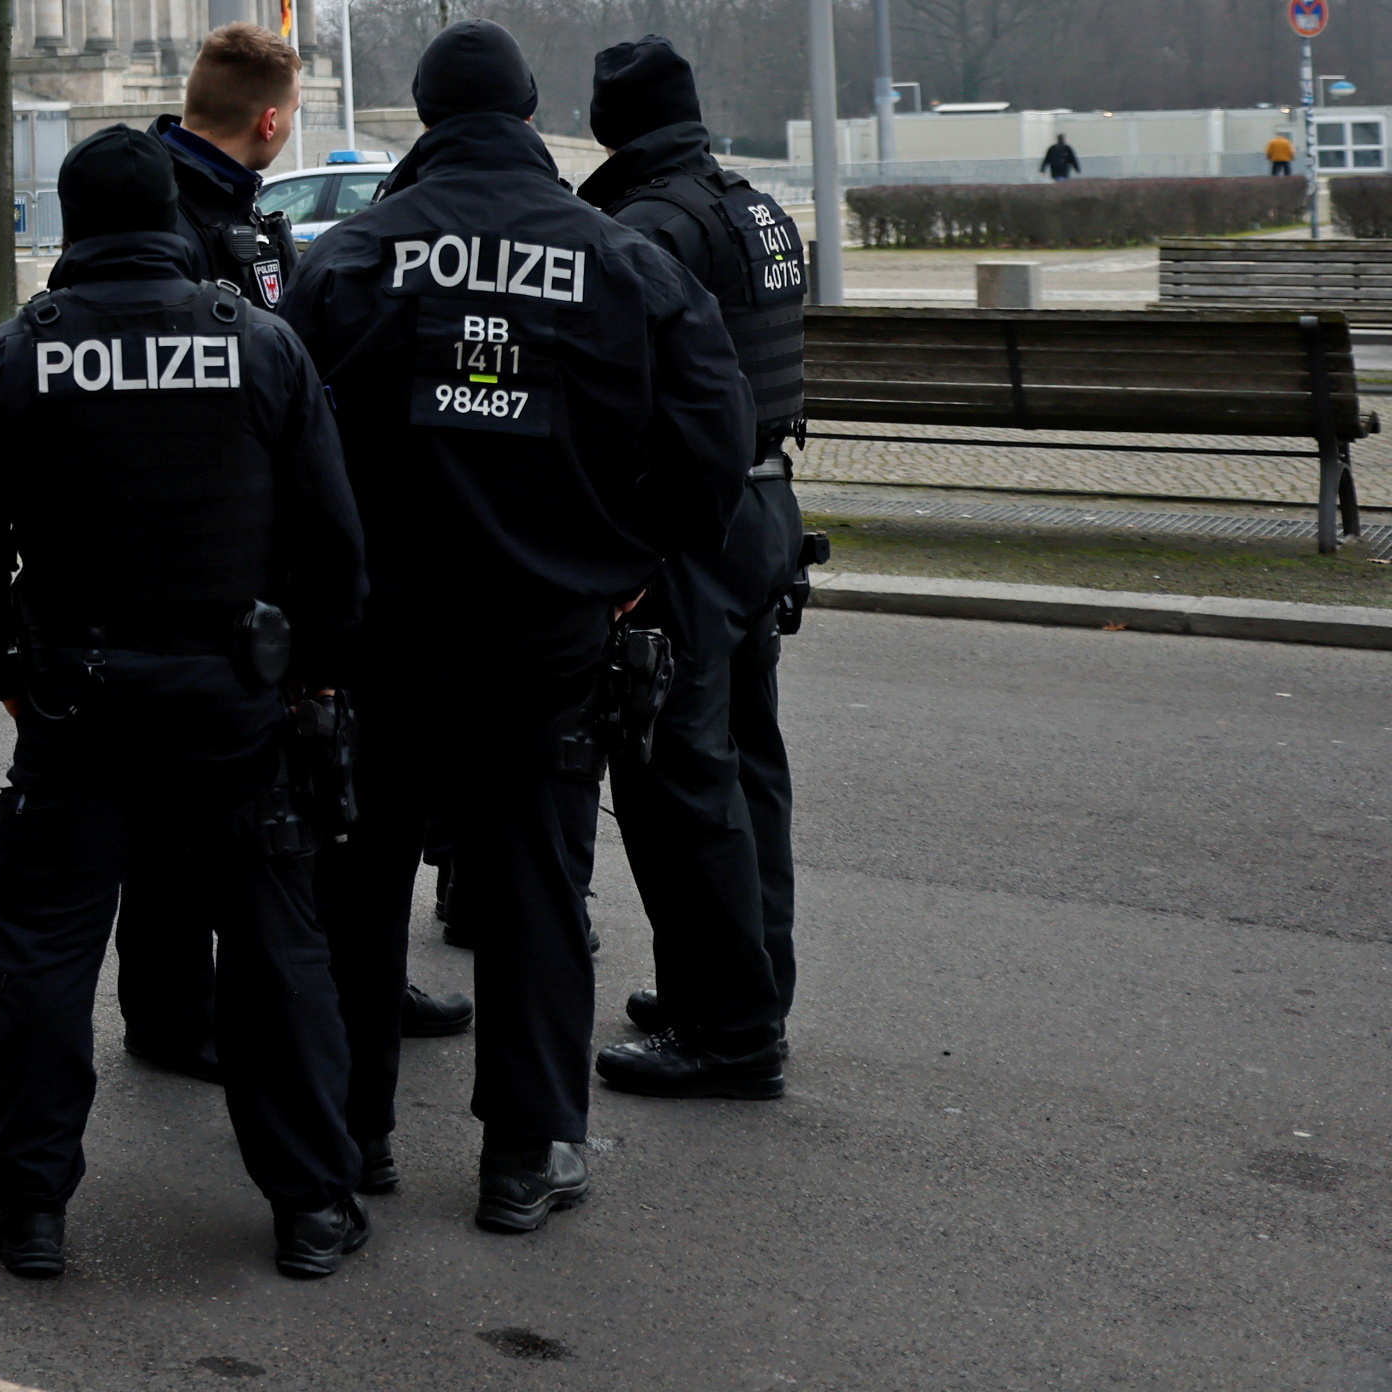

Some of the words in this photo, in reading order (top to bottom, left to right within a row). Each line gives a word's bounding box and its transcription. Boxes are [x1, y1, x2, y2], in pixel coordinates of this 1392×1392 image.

[747, 204, 776, 227] BB
[759, 225, 792, 255] 1411
[257, 263, 279, 275] POLIZEI
[392, 234, 586, 303] POLIZEI
[764, 259, 801, 291] 40715
[464, 315, 509, 344] BB
[36, 335, 241, 393] POLIZEI
[453, 341, 520, 375] 1411
[435, 384, 529, 420] 98487
